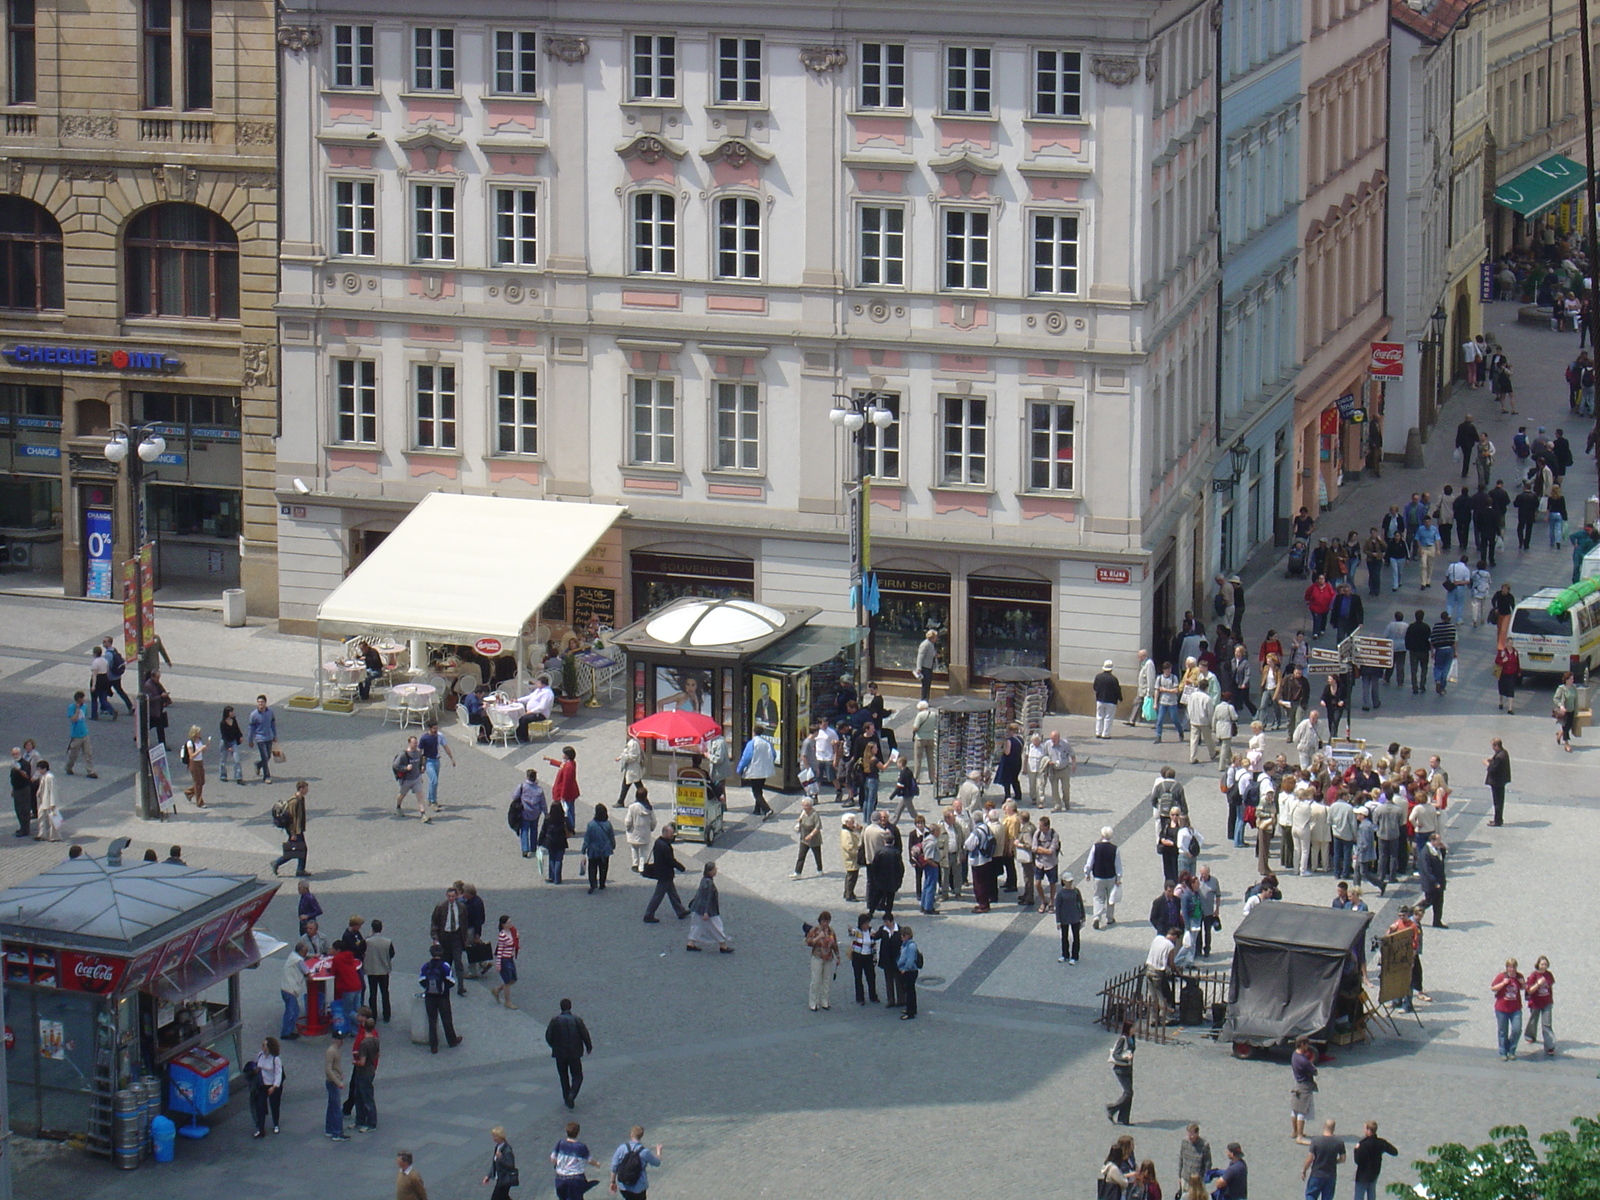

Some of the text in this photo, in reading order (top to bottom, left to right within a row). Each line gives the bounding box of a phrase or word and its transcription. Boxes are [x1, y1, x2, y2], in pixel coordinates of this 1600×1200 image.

[1483, 265, 1491, 298] CHANGE
[15, 344, 165, 369] CHEQUEPOINT
[1373, 348, 1402, 360] Coca-Cola
[26, 446, 57, 457] CHANGE
[660, 562, 729, 576] SOUVENIRS
[878, 579, 945, 591] FIRM SHOP
[982, 586, 1039, 599] BOHEMIA
[74, 961, 114, 981] Coca-Cola
